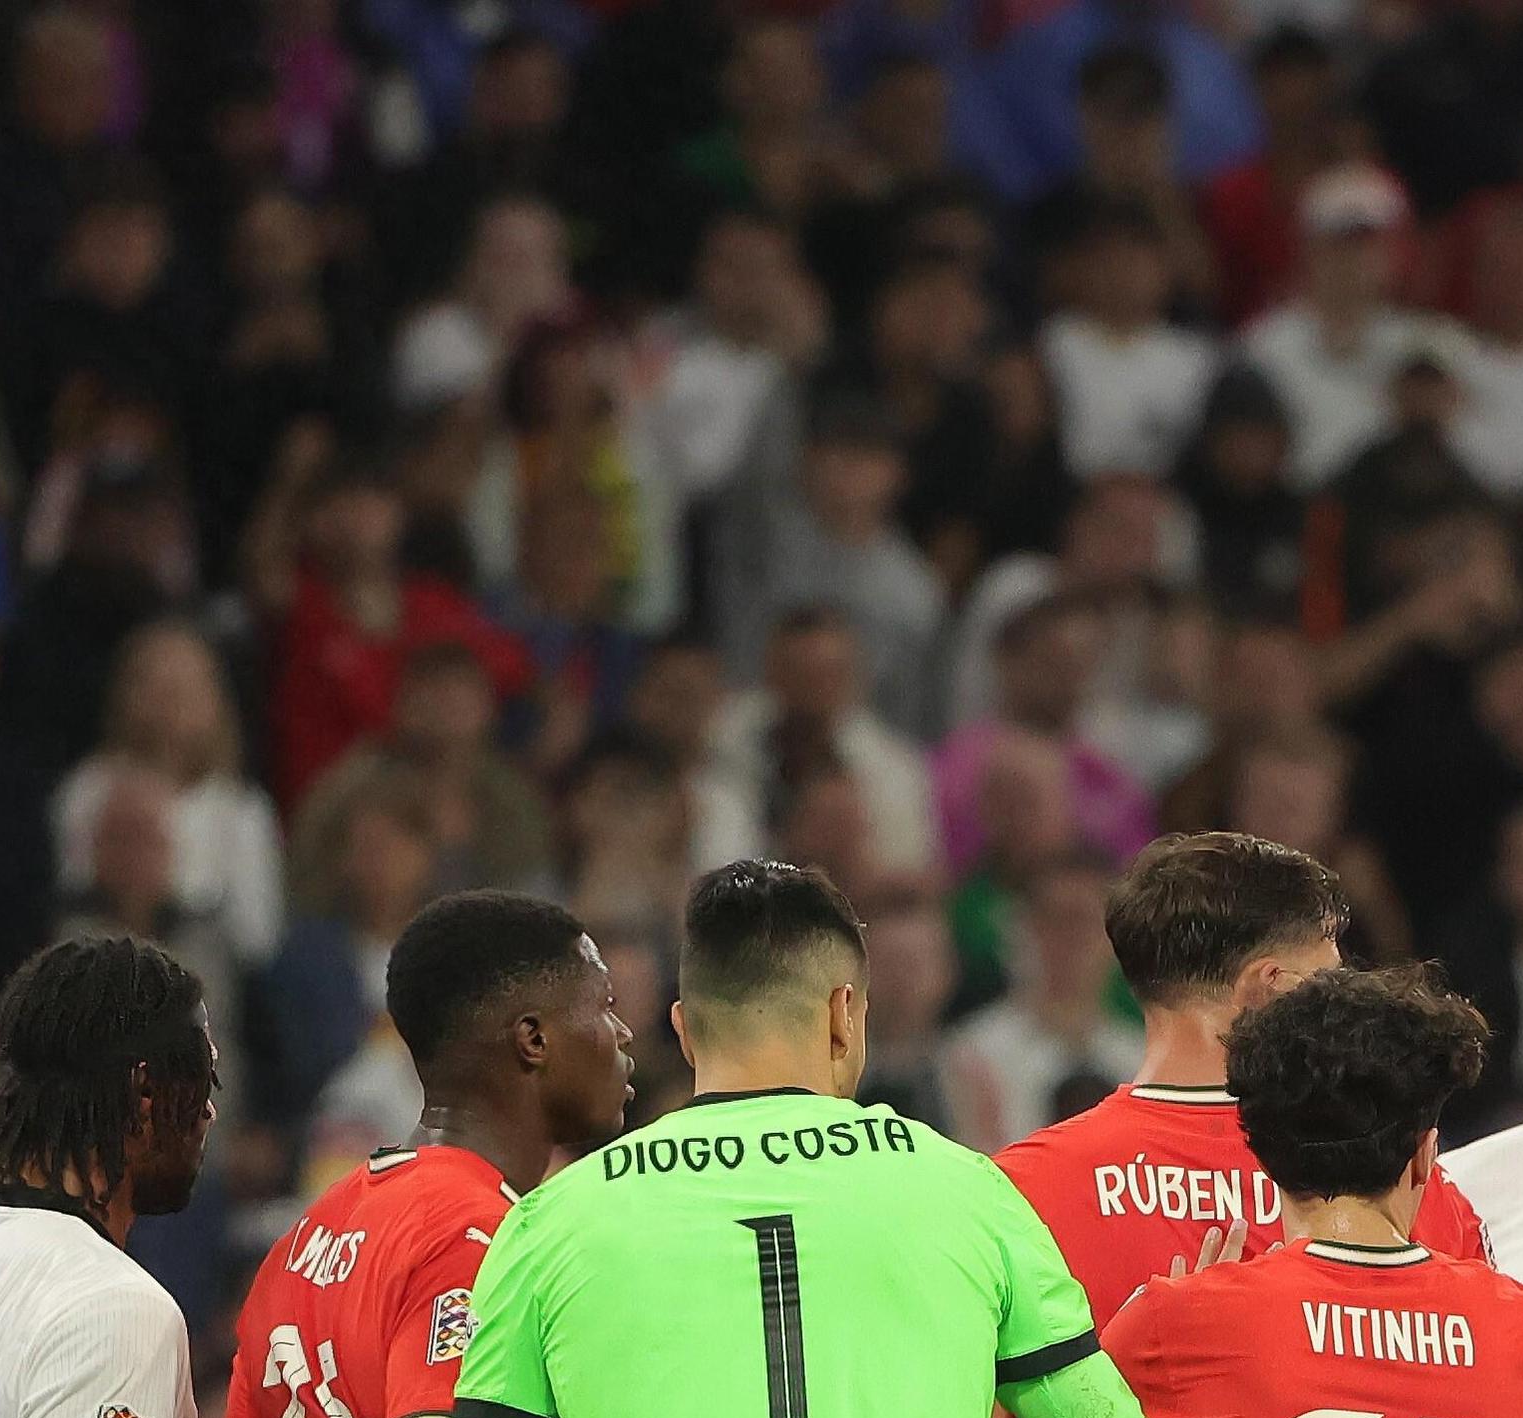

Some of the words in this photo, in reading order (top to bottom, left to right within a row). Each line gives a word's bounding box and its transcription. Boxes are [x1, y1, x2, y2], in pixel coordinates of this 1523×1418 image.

[603, 1136, 745, 1182] DIOGO
[760, 1117, 915, 1165] COSTA
[1094, 1152, 1244, 1222] RÚBEN
[1301, 1300, 1475, 1368] VITINHA
